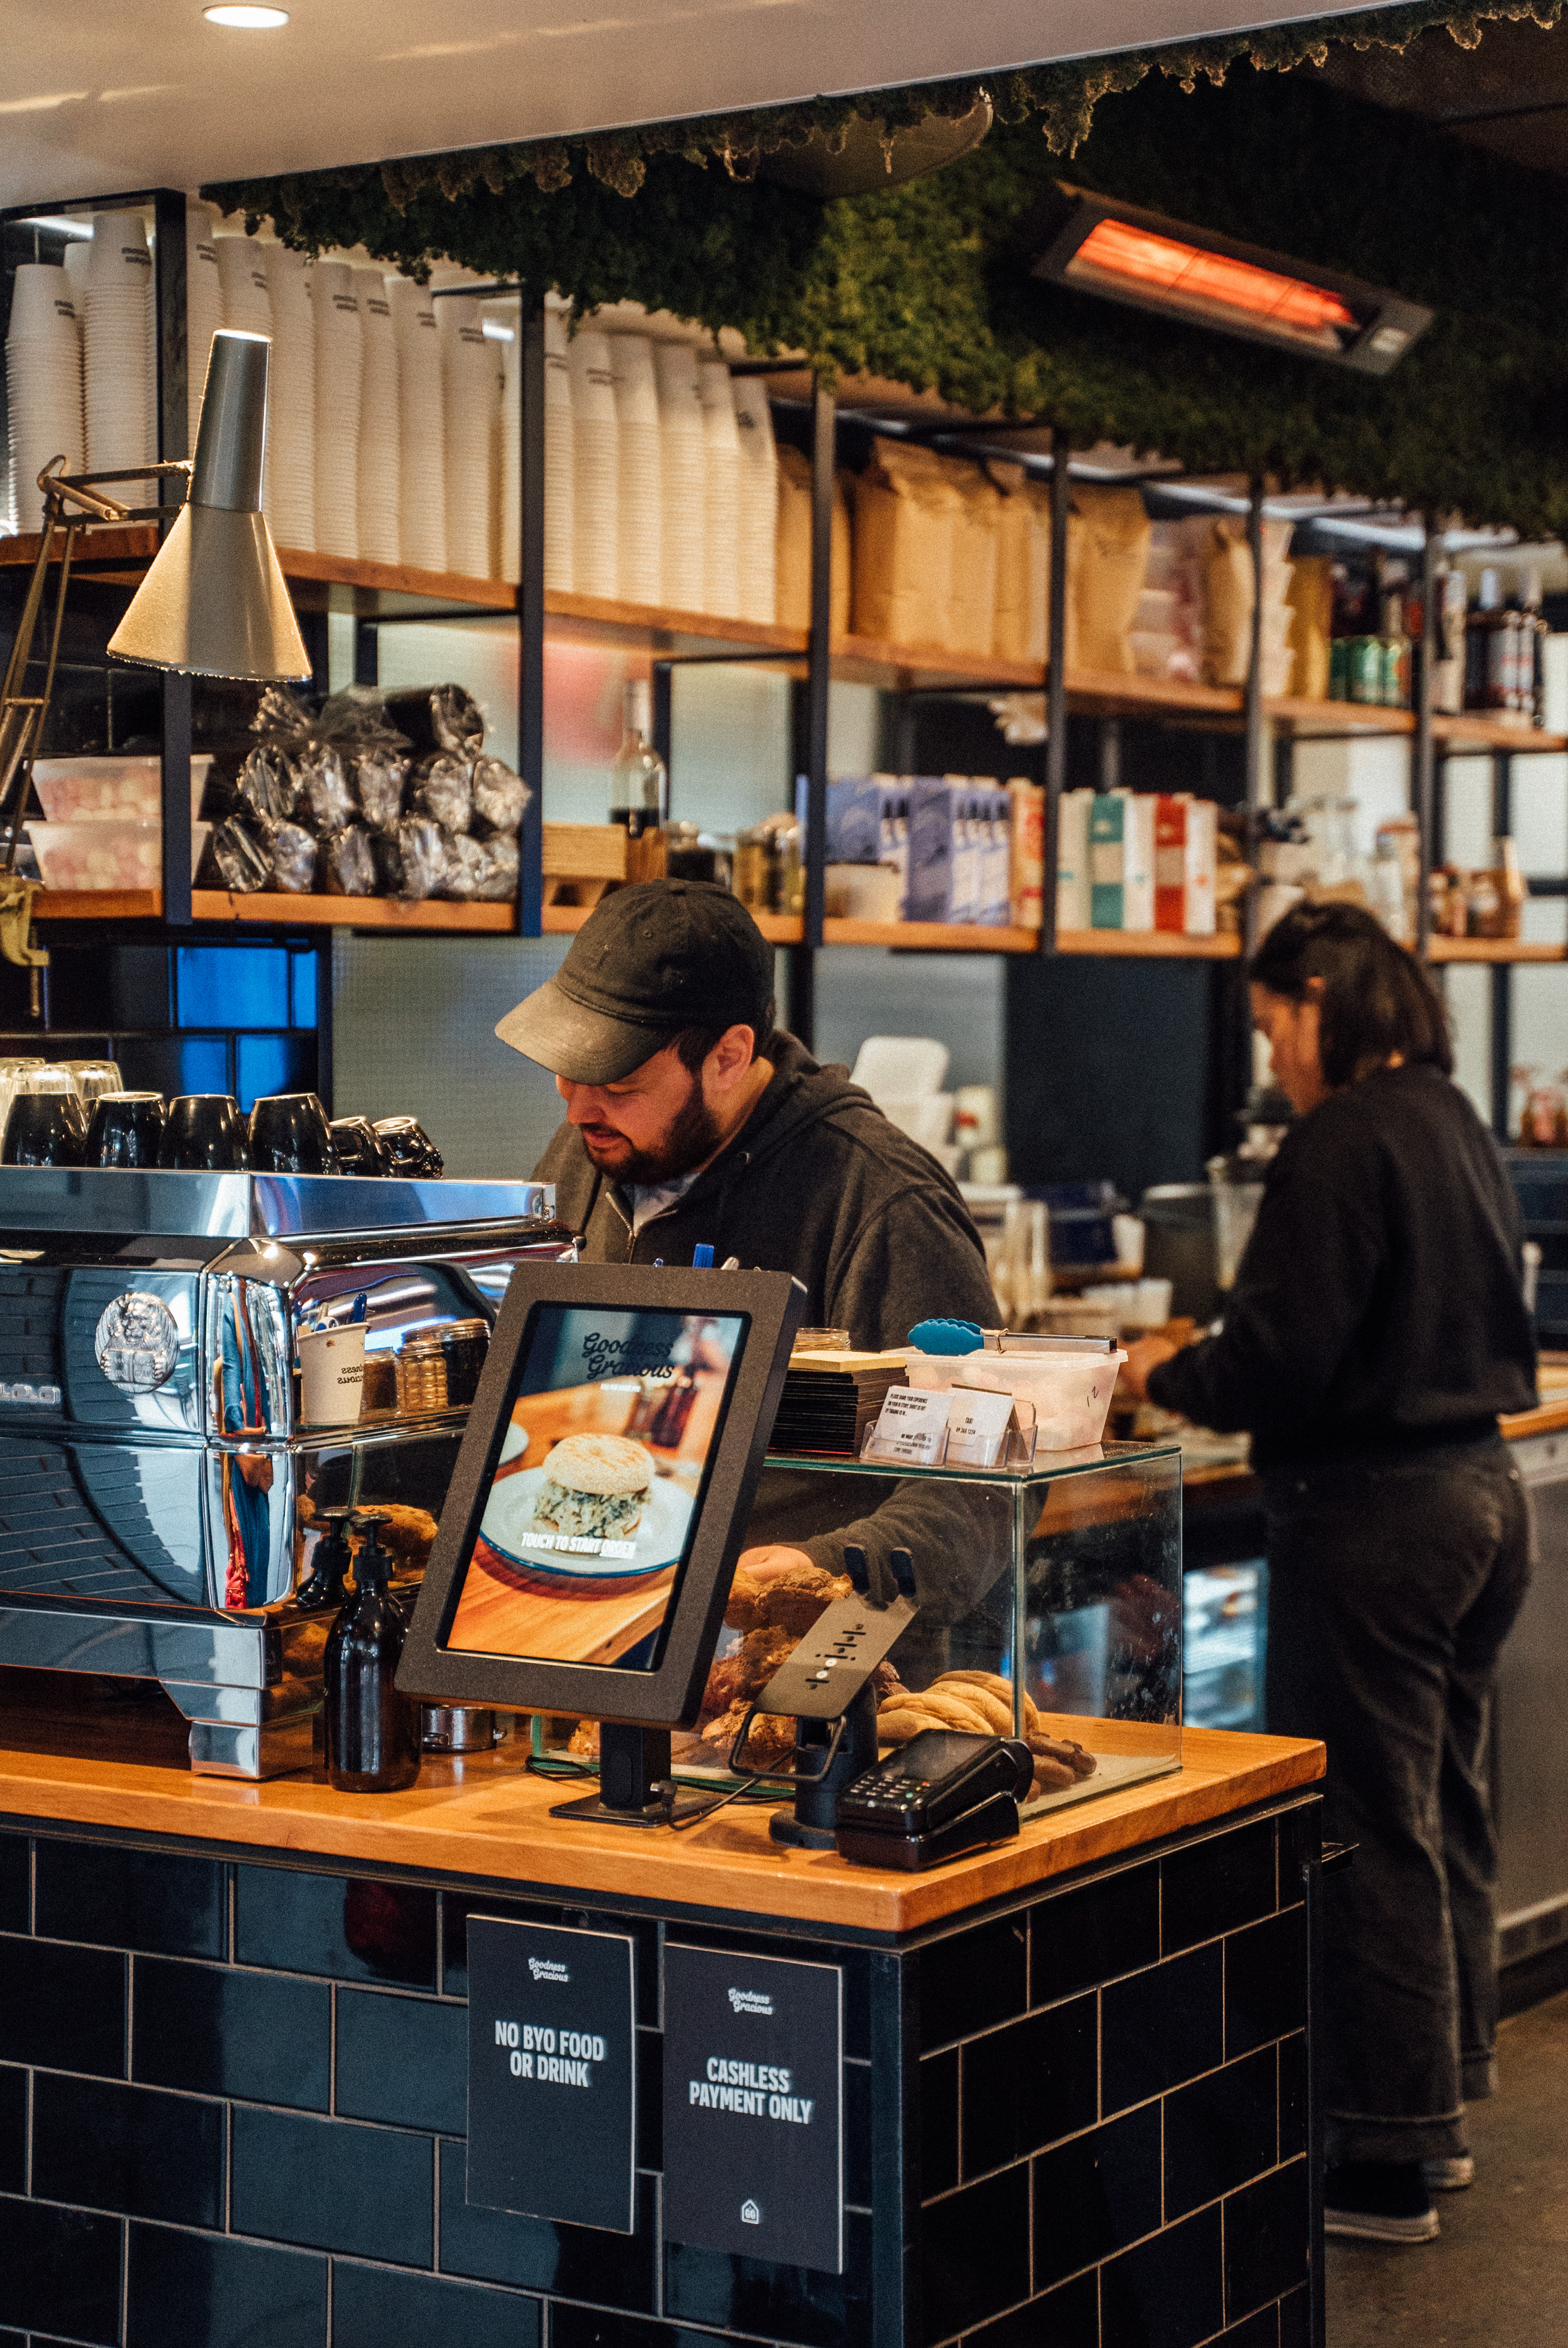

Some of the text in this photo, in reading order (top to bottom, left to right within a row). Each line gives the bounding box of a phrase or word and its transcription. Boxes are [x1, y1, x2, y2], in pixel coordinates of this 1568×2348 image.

[521, 1532, 554, 1549] TOUCH
[555, 1535, 569, 1551] TO
[569, 1536, 602, 1553] START
[528, 1957, 566, 1973] Goodness
[533, 1968, 569, 1982] Gracious
[728, 1987, 770, 2005] Goodness
[733, 2000, 773, 2015] Gracious
[495, 2020, 604, 2061] NO BYO FOOD
[510, 2051, 590, 2087] OR DRINK
[707, 2057, 790, 2094] CASHLESS
[689, 2081, 812, 2124] PAYMENT ONLY
